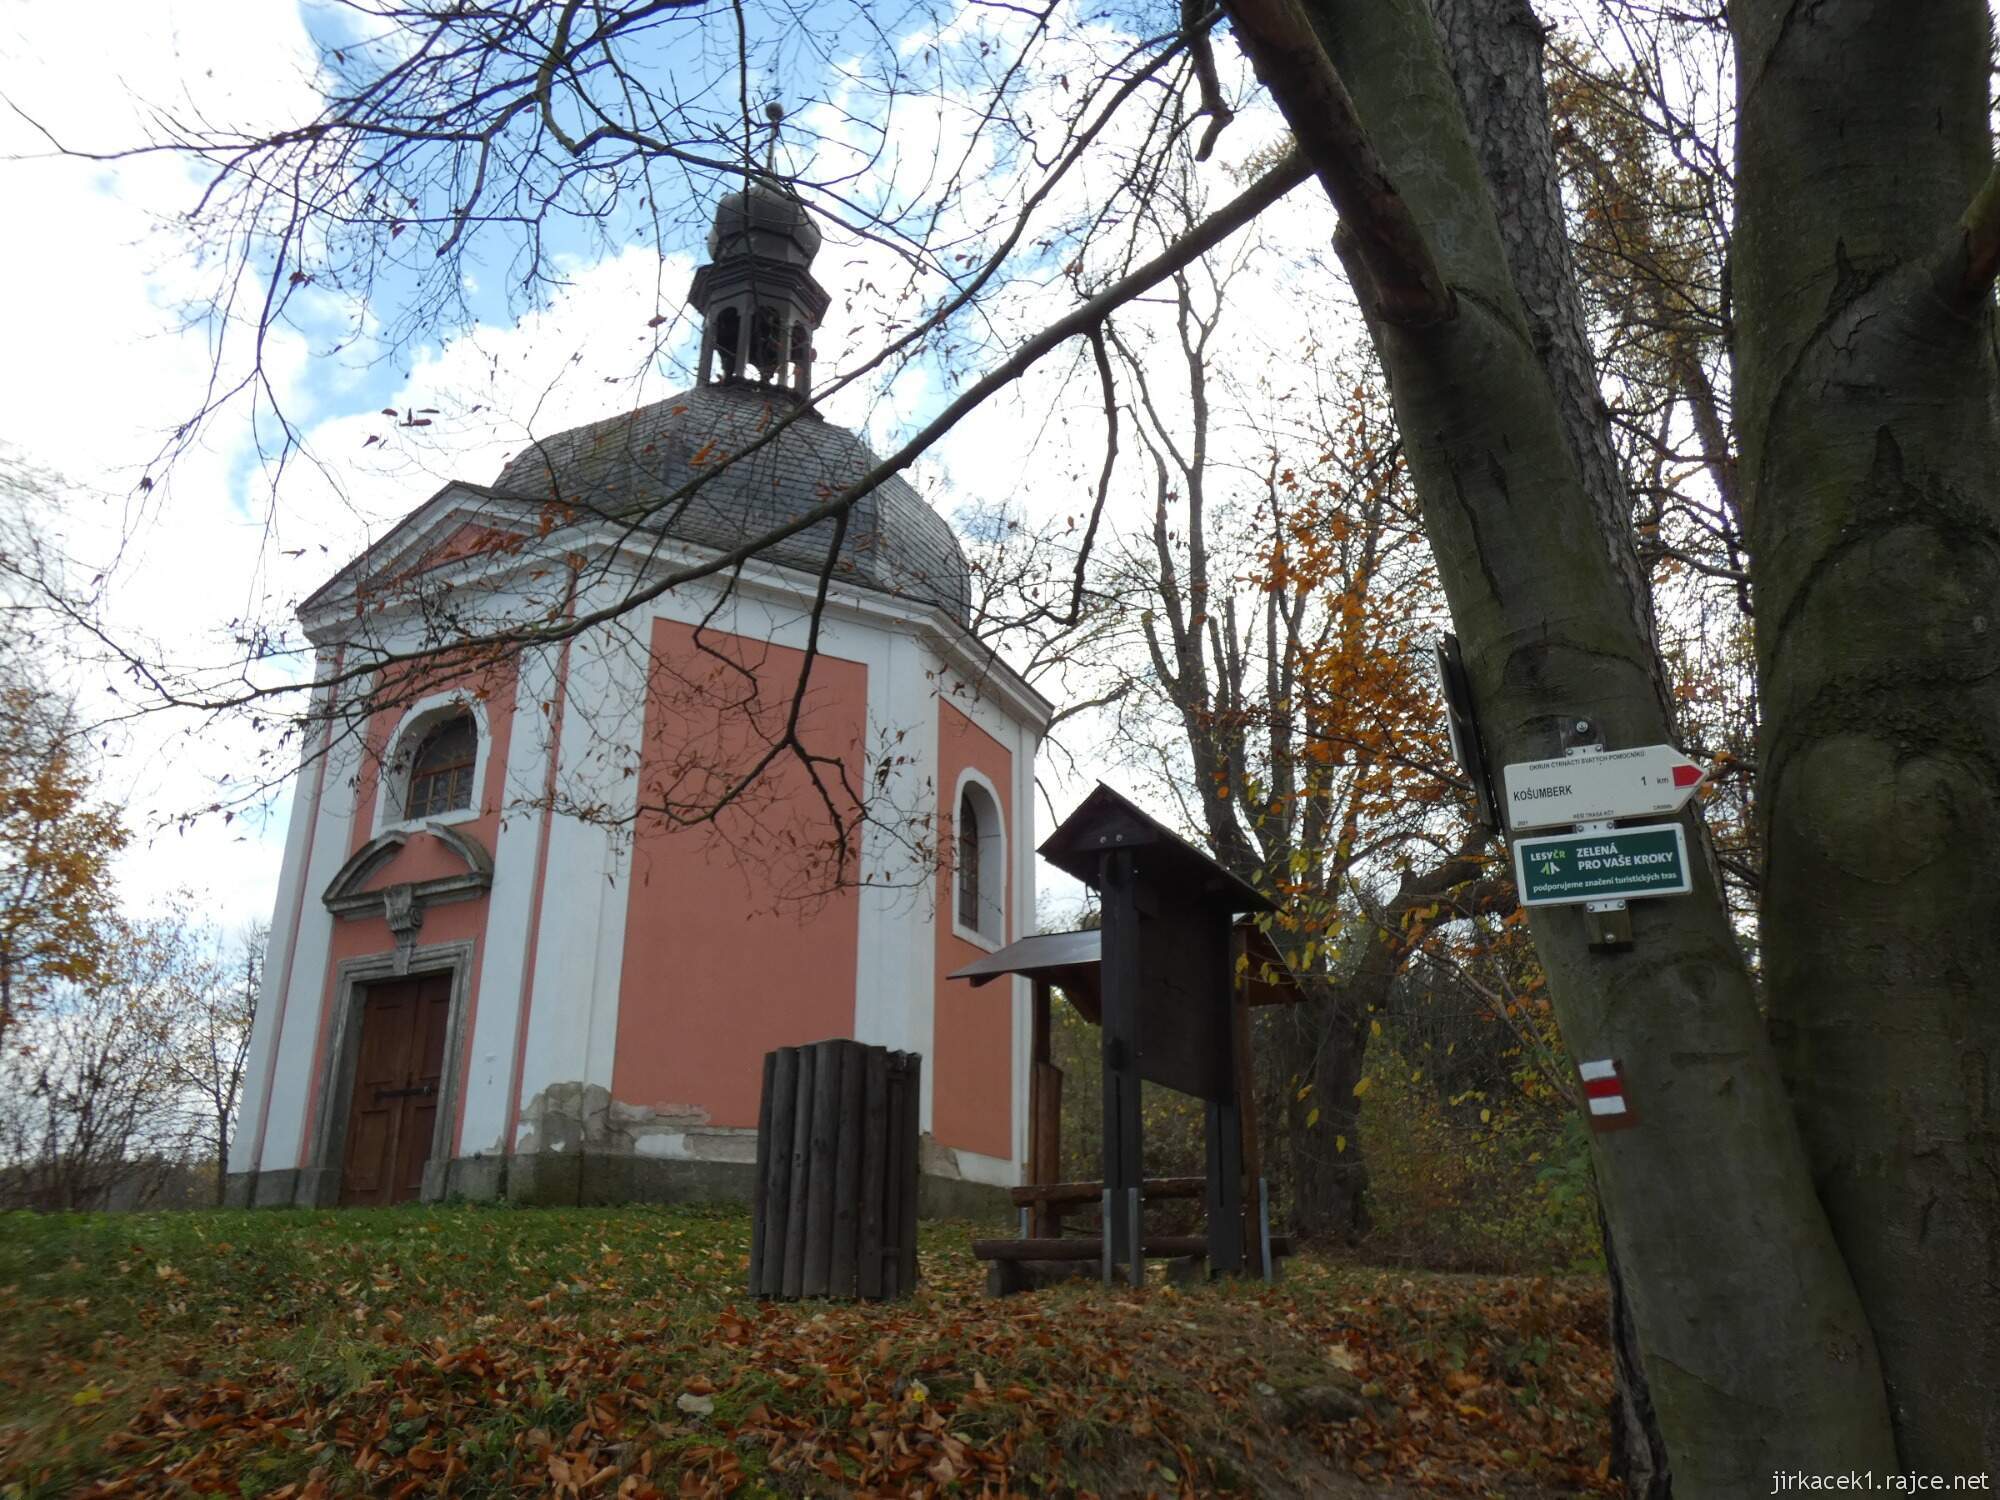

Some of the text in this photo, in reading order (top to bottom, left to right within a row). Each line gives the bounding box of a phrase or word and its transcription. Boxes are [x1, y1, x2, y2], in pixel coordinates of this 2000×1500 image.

[1641, 775, 1647, 786] 1
[1513, 784, 1573, 801] KOŠUMBERK
[1576, 842, 1618, 857] ZELENÁ
[1578, 852, 1673, 870] PRO VAŠE KROKY
[1533, 881, 1583, 893] podporujeme
[1585, 877, 1614, 887] značení
[1615, 873, 1660, 884] turistických
